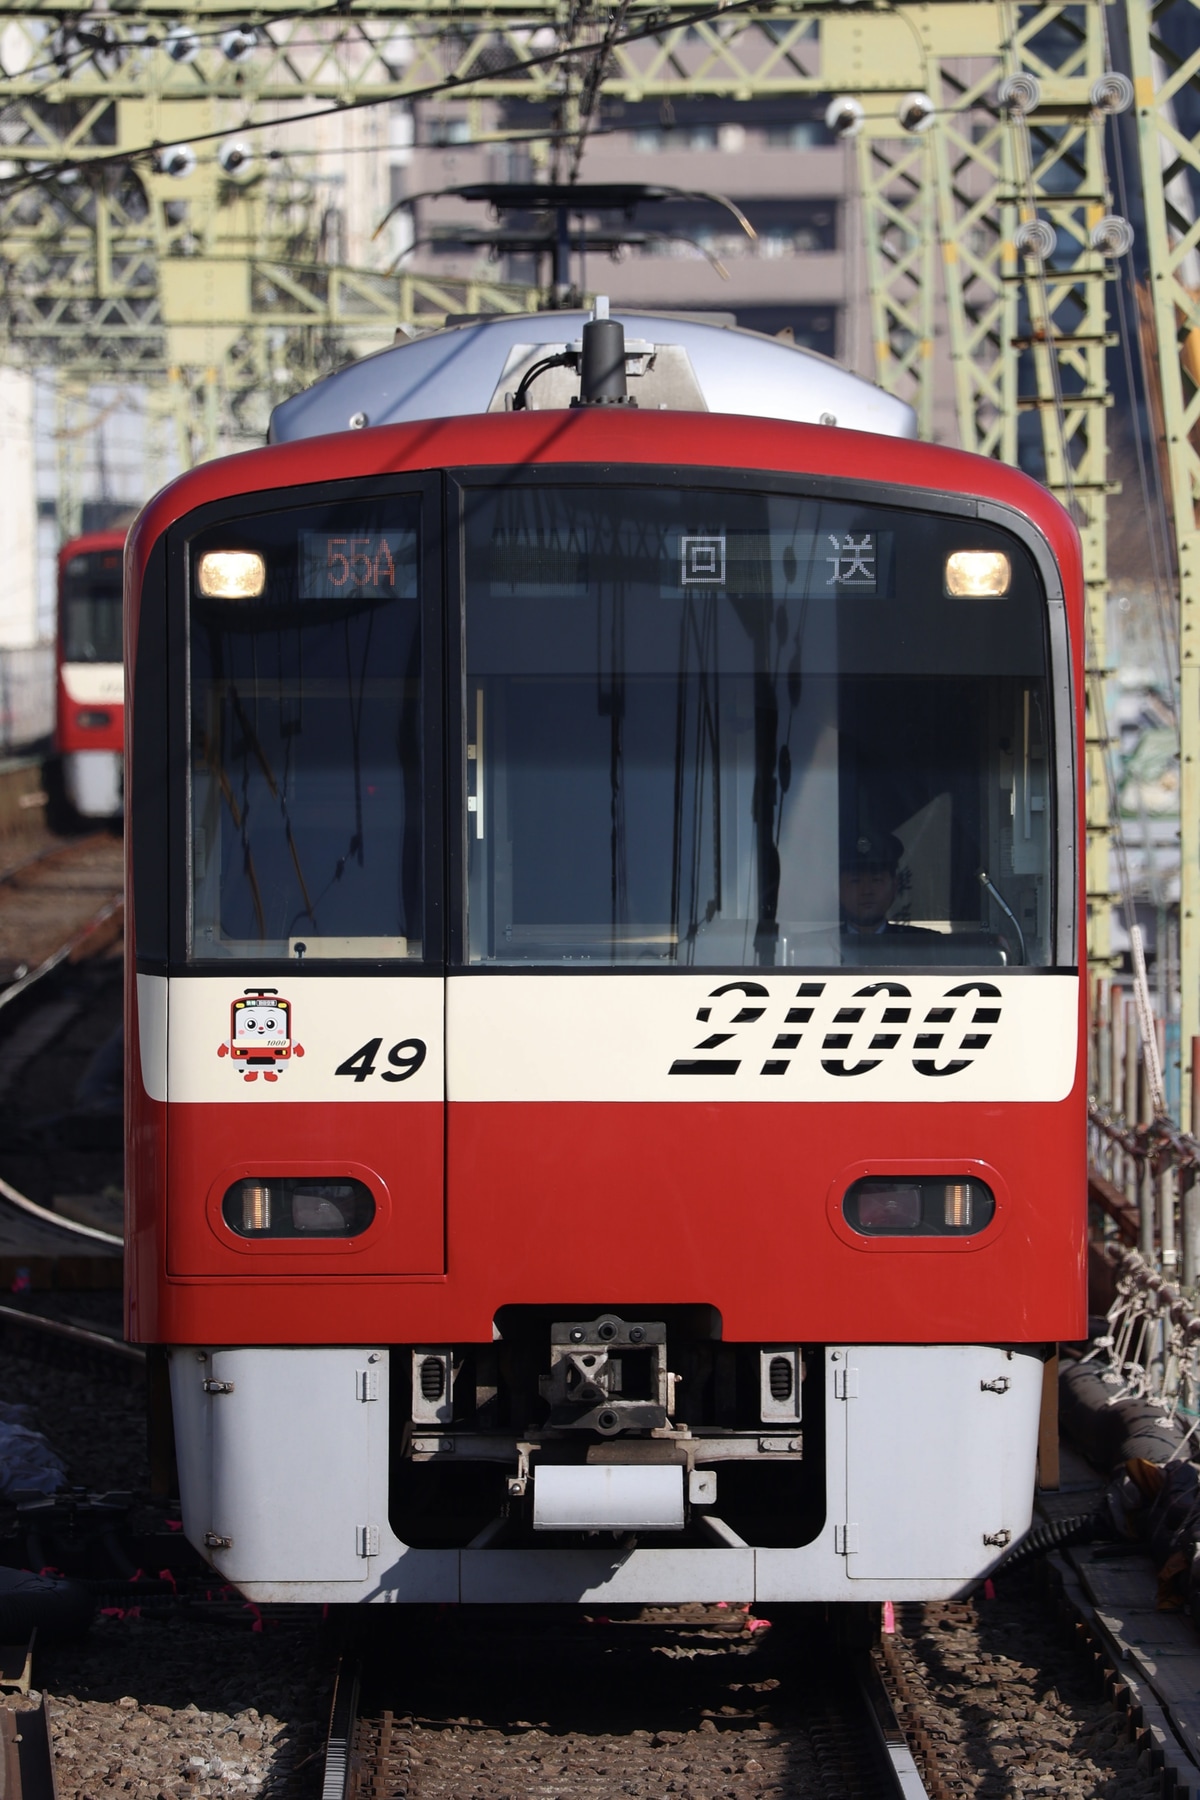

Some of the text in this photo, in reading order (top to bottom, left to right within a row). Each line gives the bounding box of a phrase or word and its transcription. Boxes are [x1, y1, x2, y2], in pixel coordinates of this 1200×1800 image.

[327, 538, 395, 586] 55A
[667, 981, 1003, 1077] 2100
[334, 1037, 427, 1083] 49
